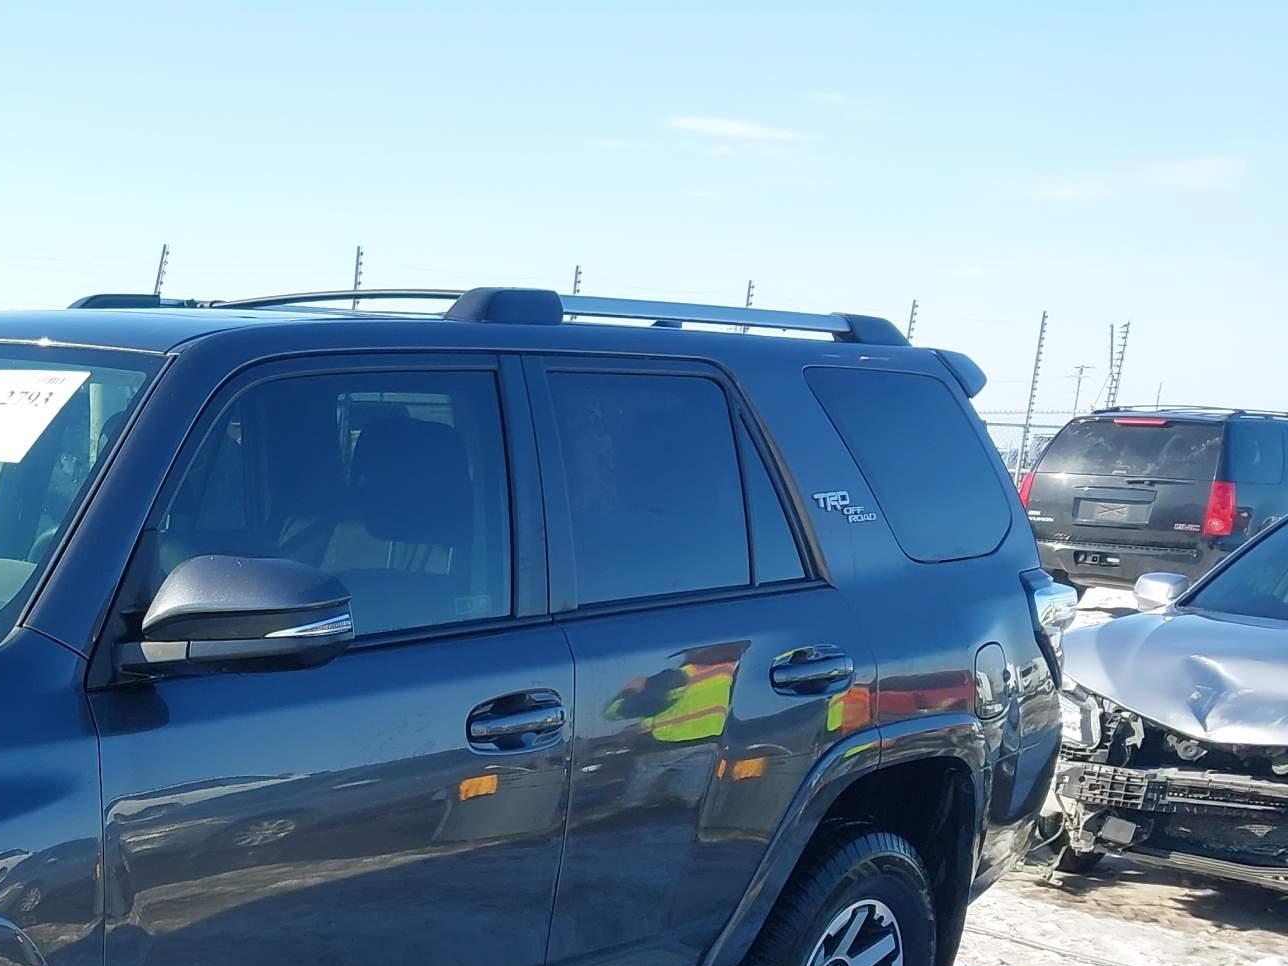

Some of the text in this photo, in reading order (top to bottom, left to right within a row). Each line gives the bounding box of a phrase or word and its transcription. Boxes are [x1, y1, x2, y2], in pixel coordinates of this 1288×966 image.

[813, 490, 850, 512] TRD
[843, 506, 865, 515] OFF
[848, 512, 877, 523] ROAD
